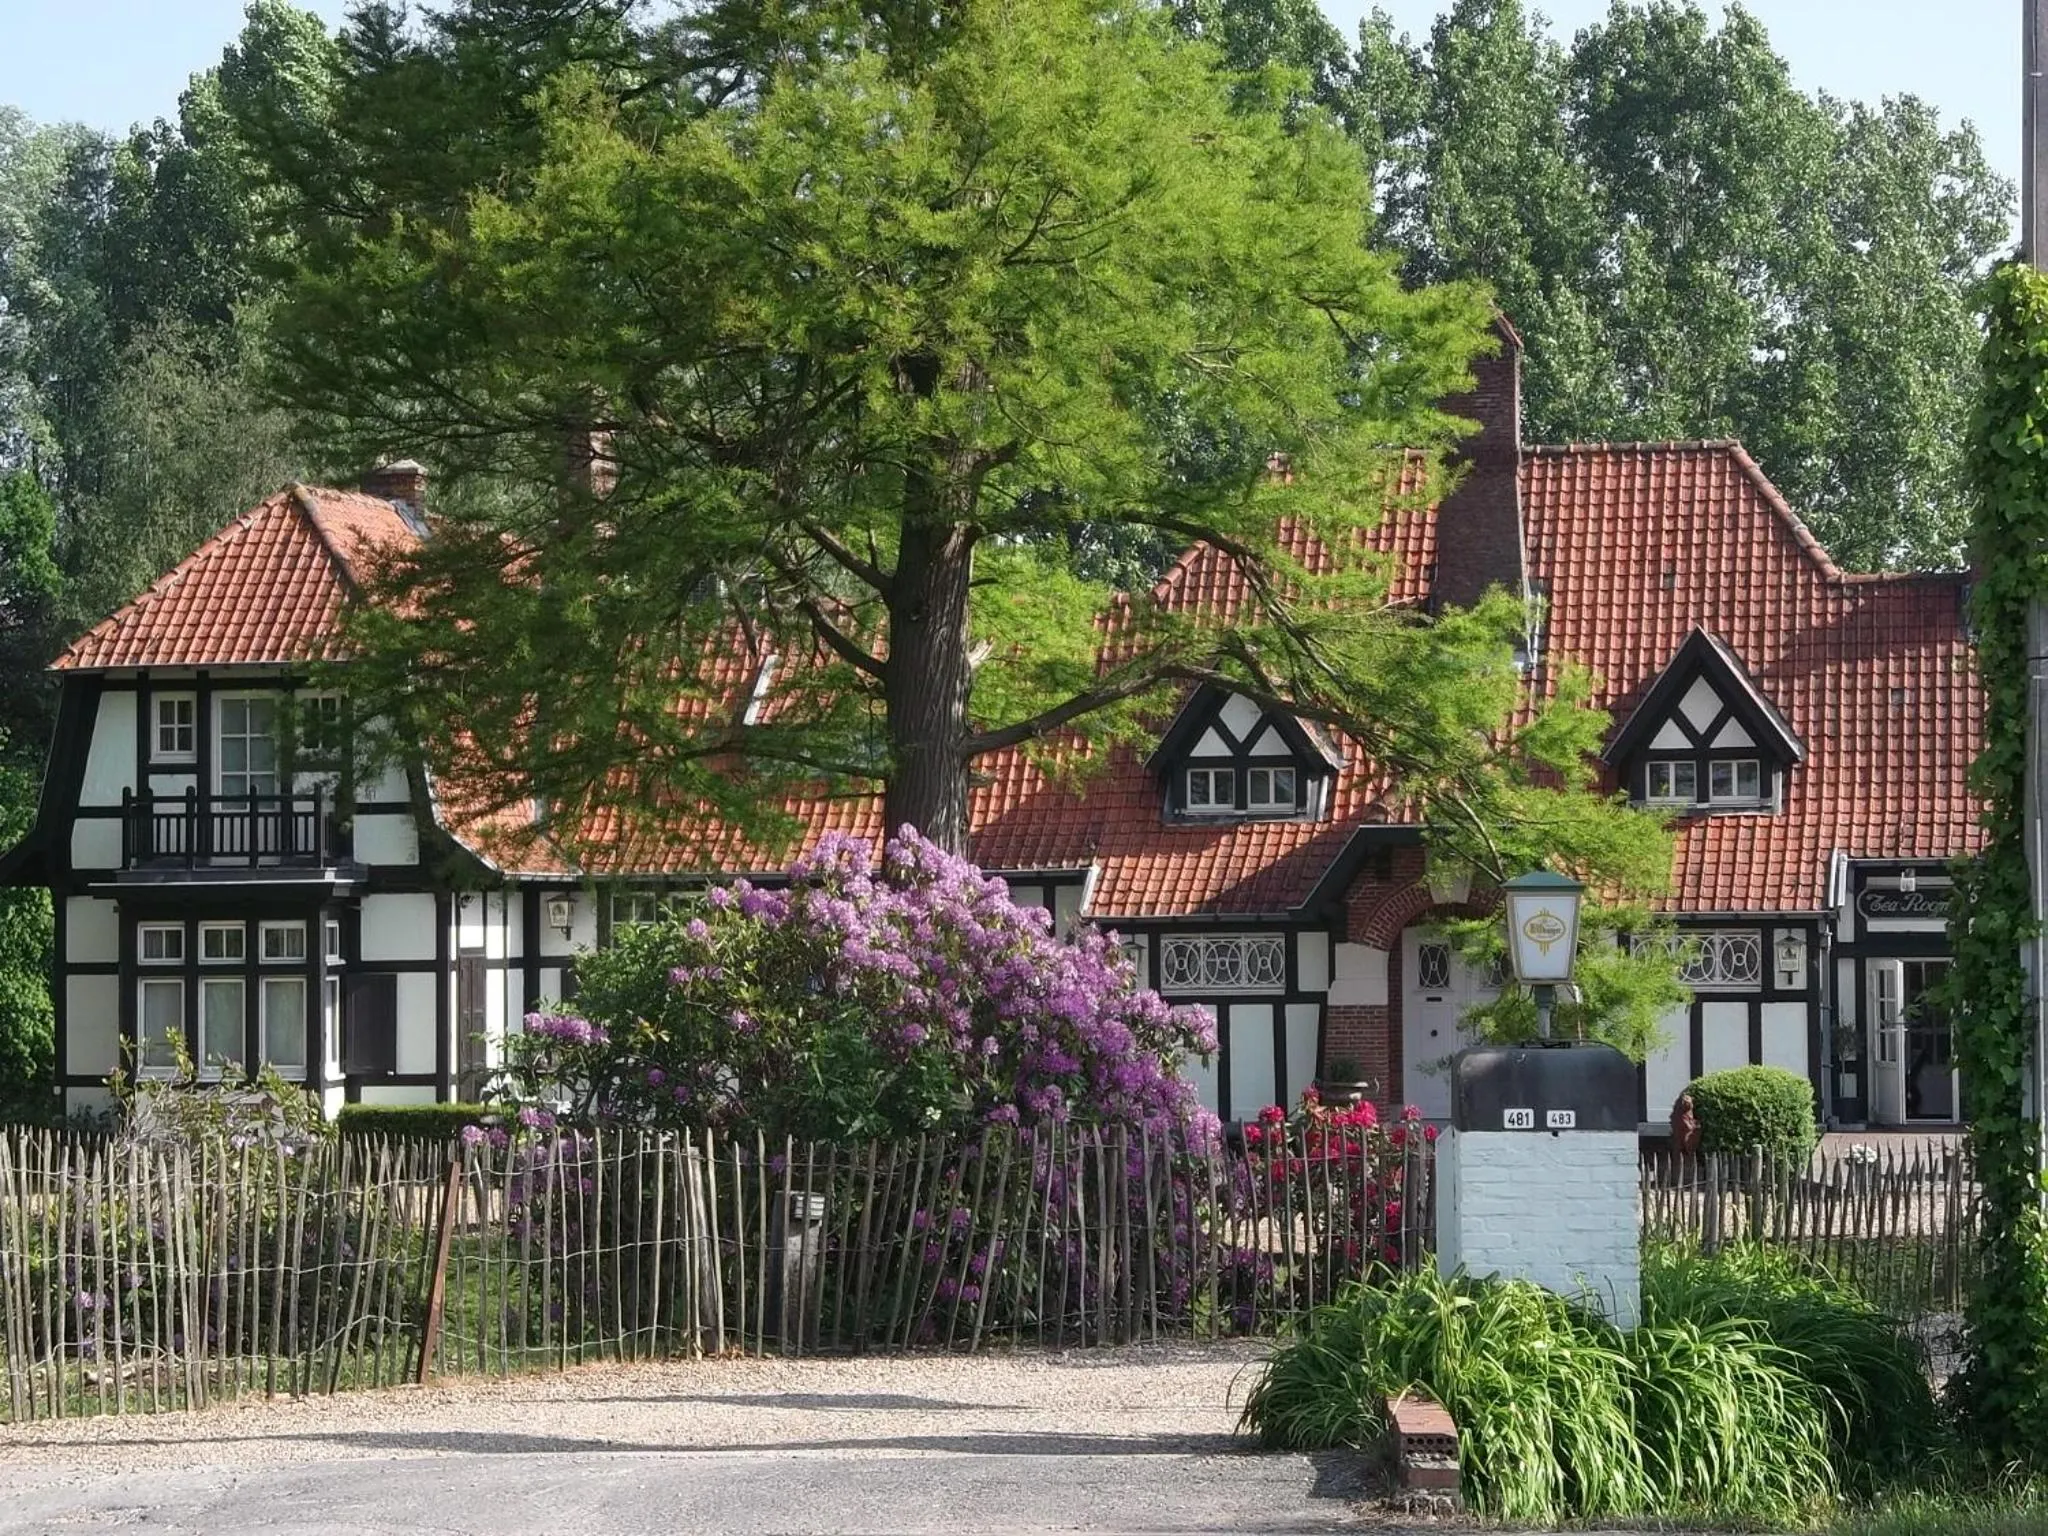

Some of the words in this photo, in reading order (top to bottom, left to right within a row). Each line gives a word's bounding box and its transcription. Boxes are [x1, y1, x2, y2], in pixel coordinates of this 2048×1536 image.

[1866, 893, 1899, 912] Tea
[1508, 1112, 1530, 1126] 481
[1551, 1113, 1571, 1125] 483
